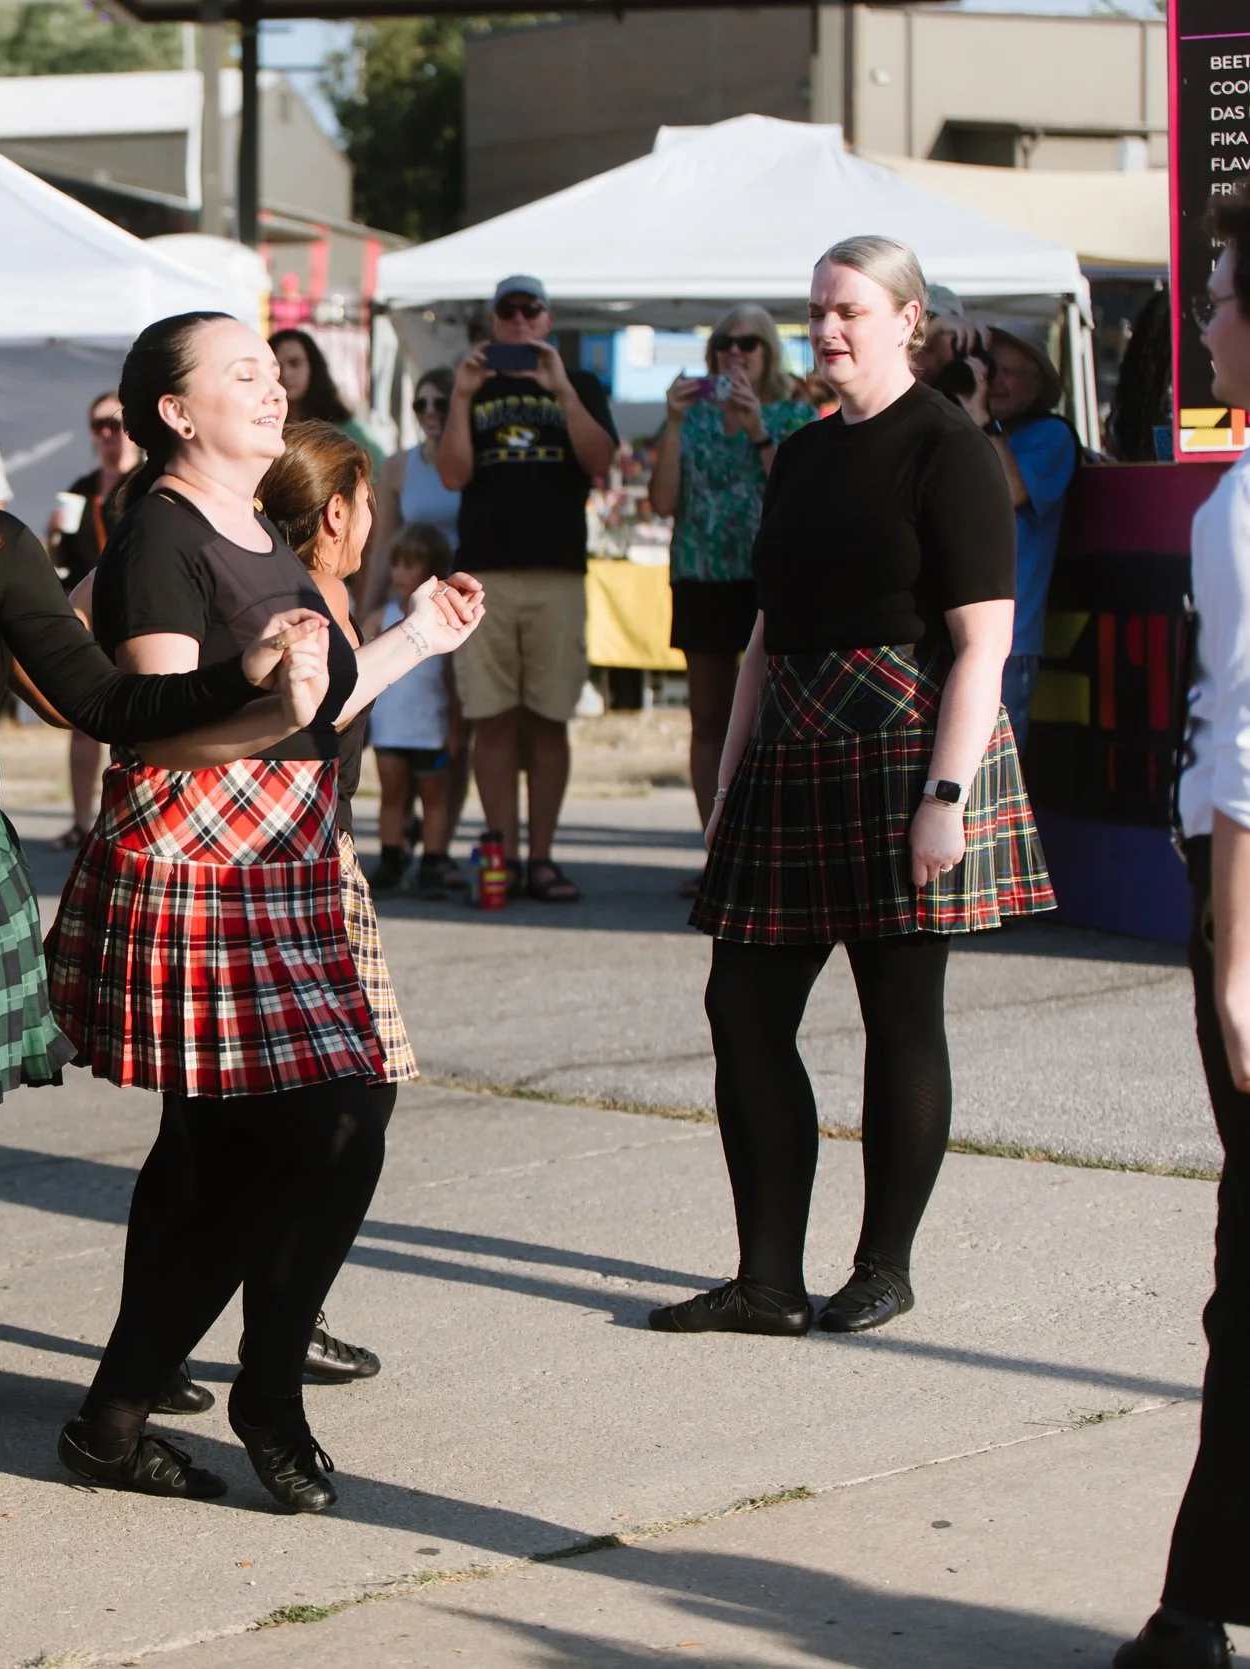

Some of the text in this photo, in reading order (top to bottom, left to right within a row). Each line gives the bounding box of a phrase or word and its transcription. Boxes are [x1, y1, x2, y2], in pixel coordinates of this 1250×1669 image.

[1210, 54, 1250, 70] BEET
[1210, 80, 1250, 95] COO
[1211, 105, 1245, 121] DAS
[1211, 131, 1249, 146] FIKA
